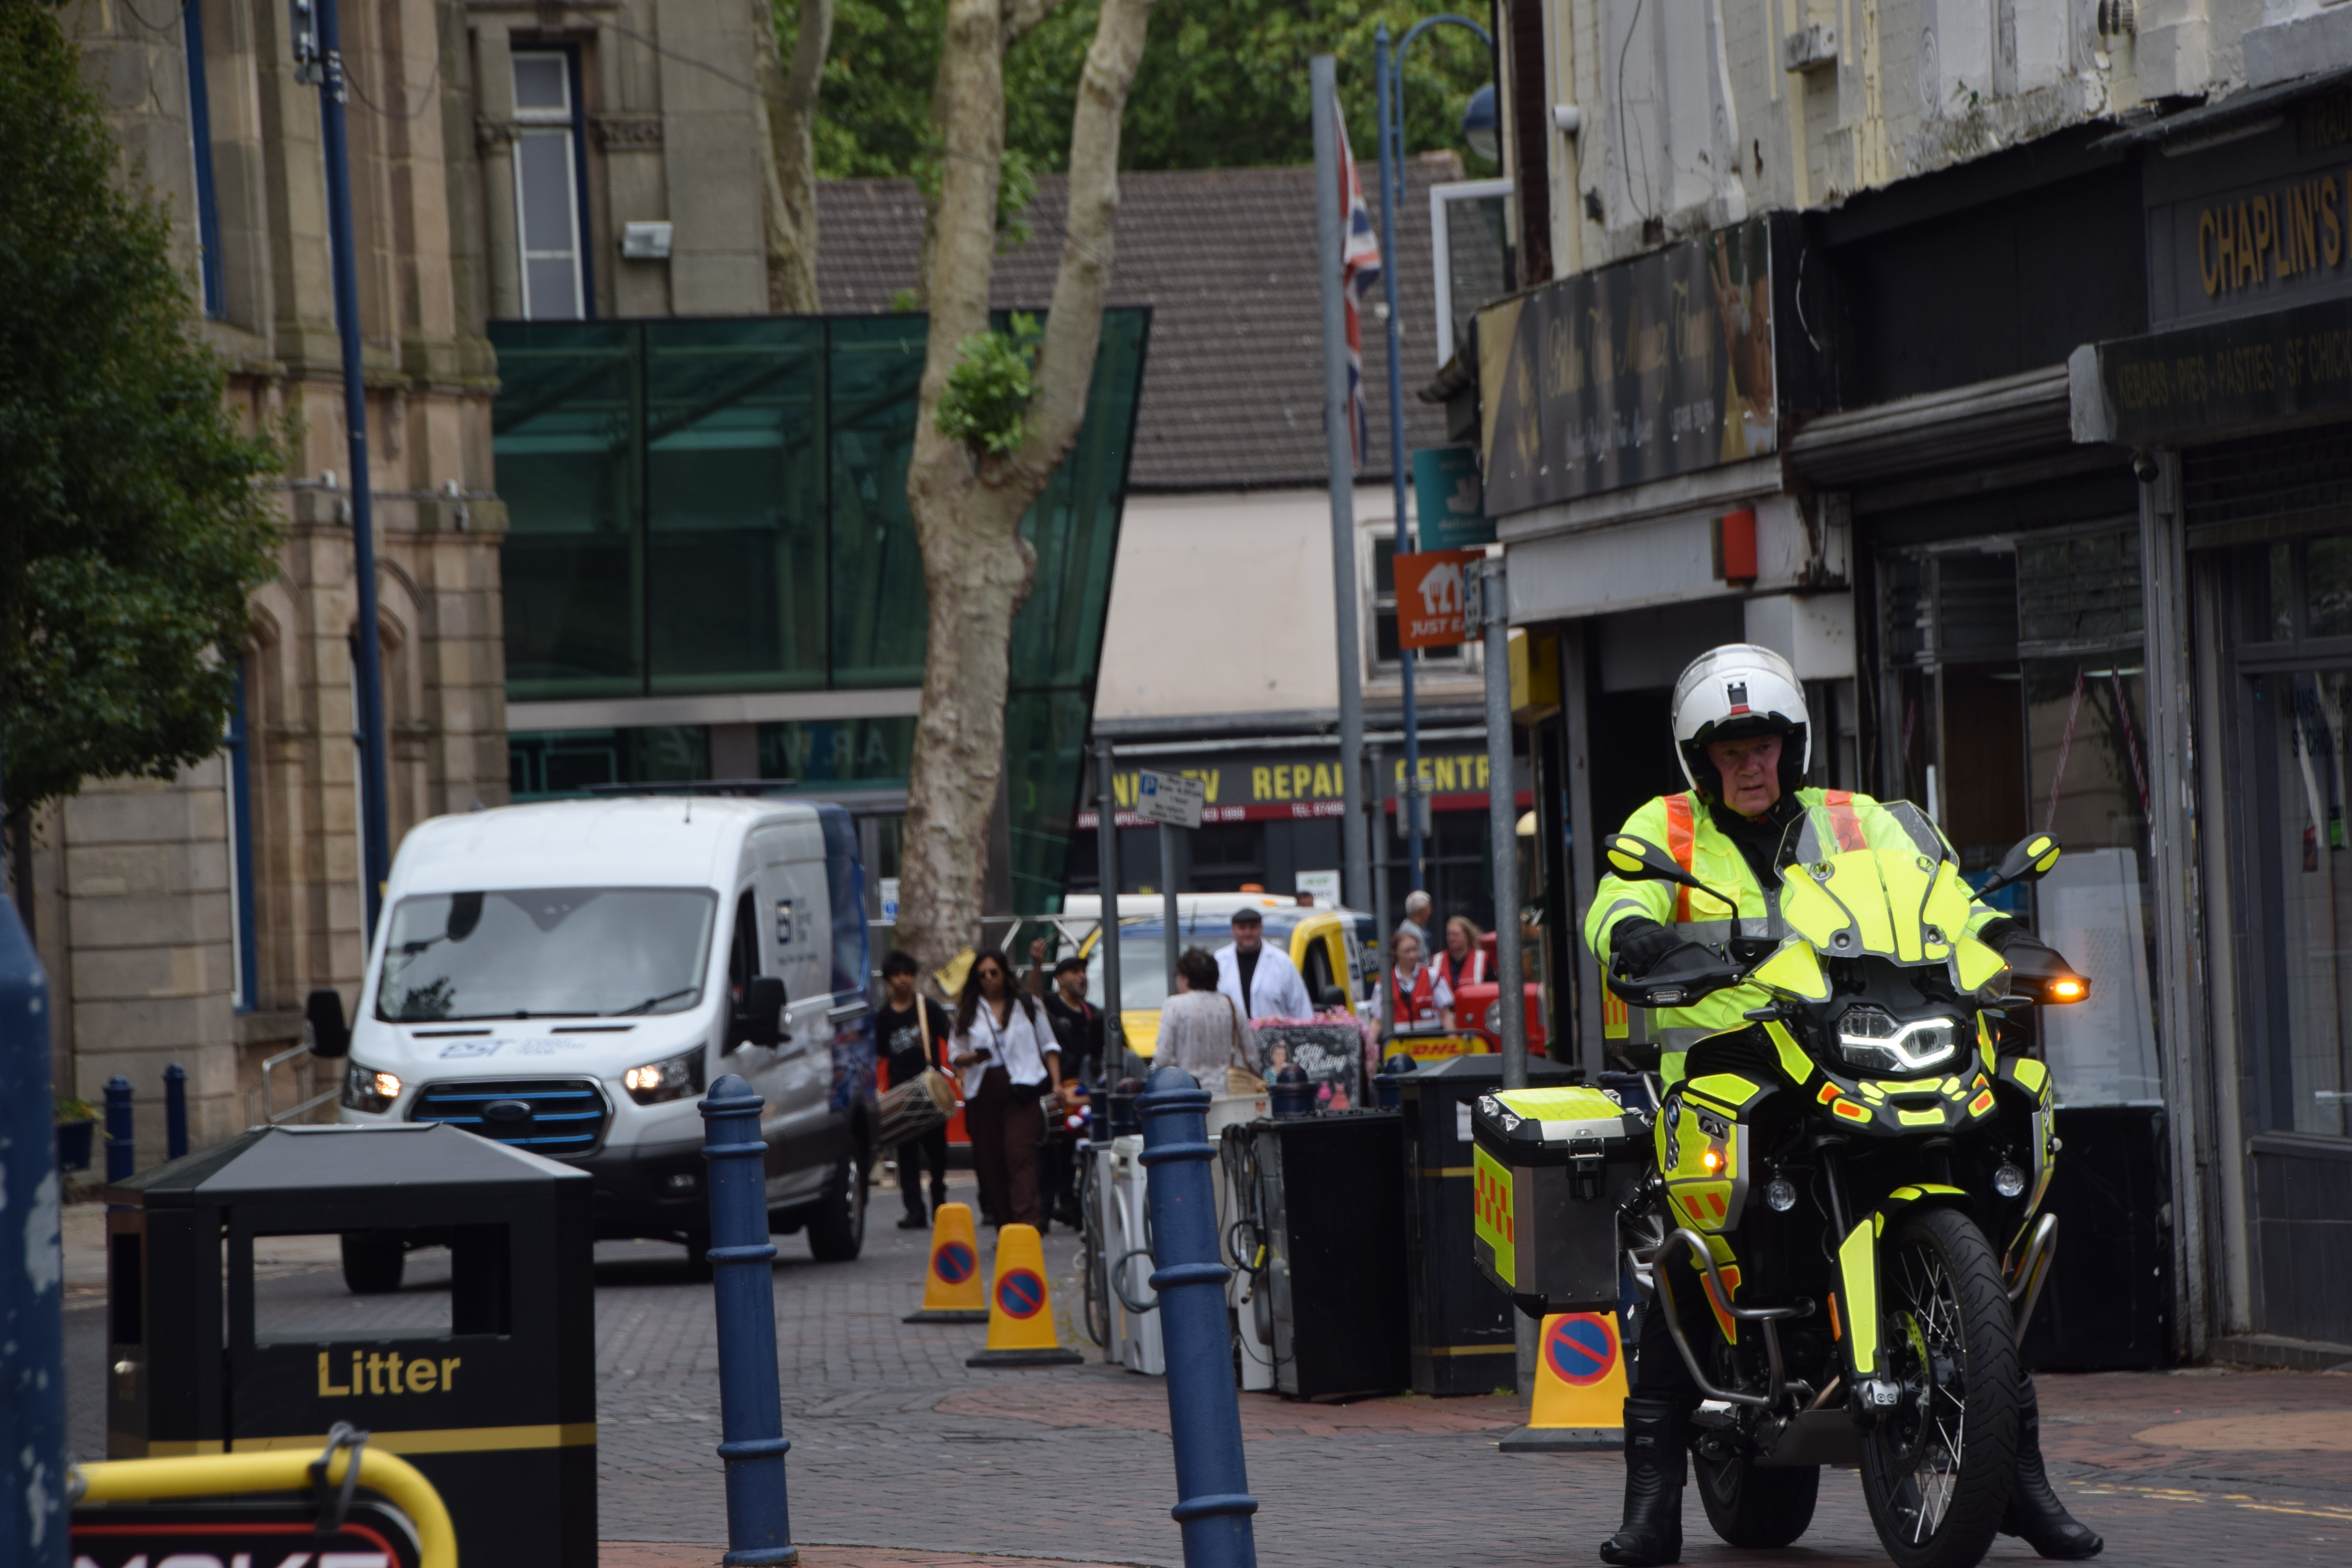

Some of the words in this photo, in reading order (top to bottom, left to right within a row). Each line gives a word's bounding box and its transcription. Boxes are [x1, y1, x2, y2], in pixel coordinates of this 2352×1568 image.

[2198, 175, 2340, 296] CHAPLIN'S
[2116, 360, 2169, 409] KEBABS
[2177, 354, 2208, 404] PIES
[2217, 343, 2275, 398] PASTIES
[1410, 617, 1450, 639] JUST
[1252, 762, 1344, 801] REPAI
[1395, 754, 1489, 791] CENTR
[1412, 1043, 1459, 1056] DHL
[318, 1351, 461, 1397] Litter
